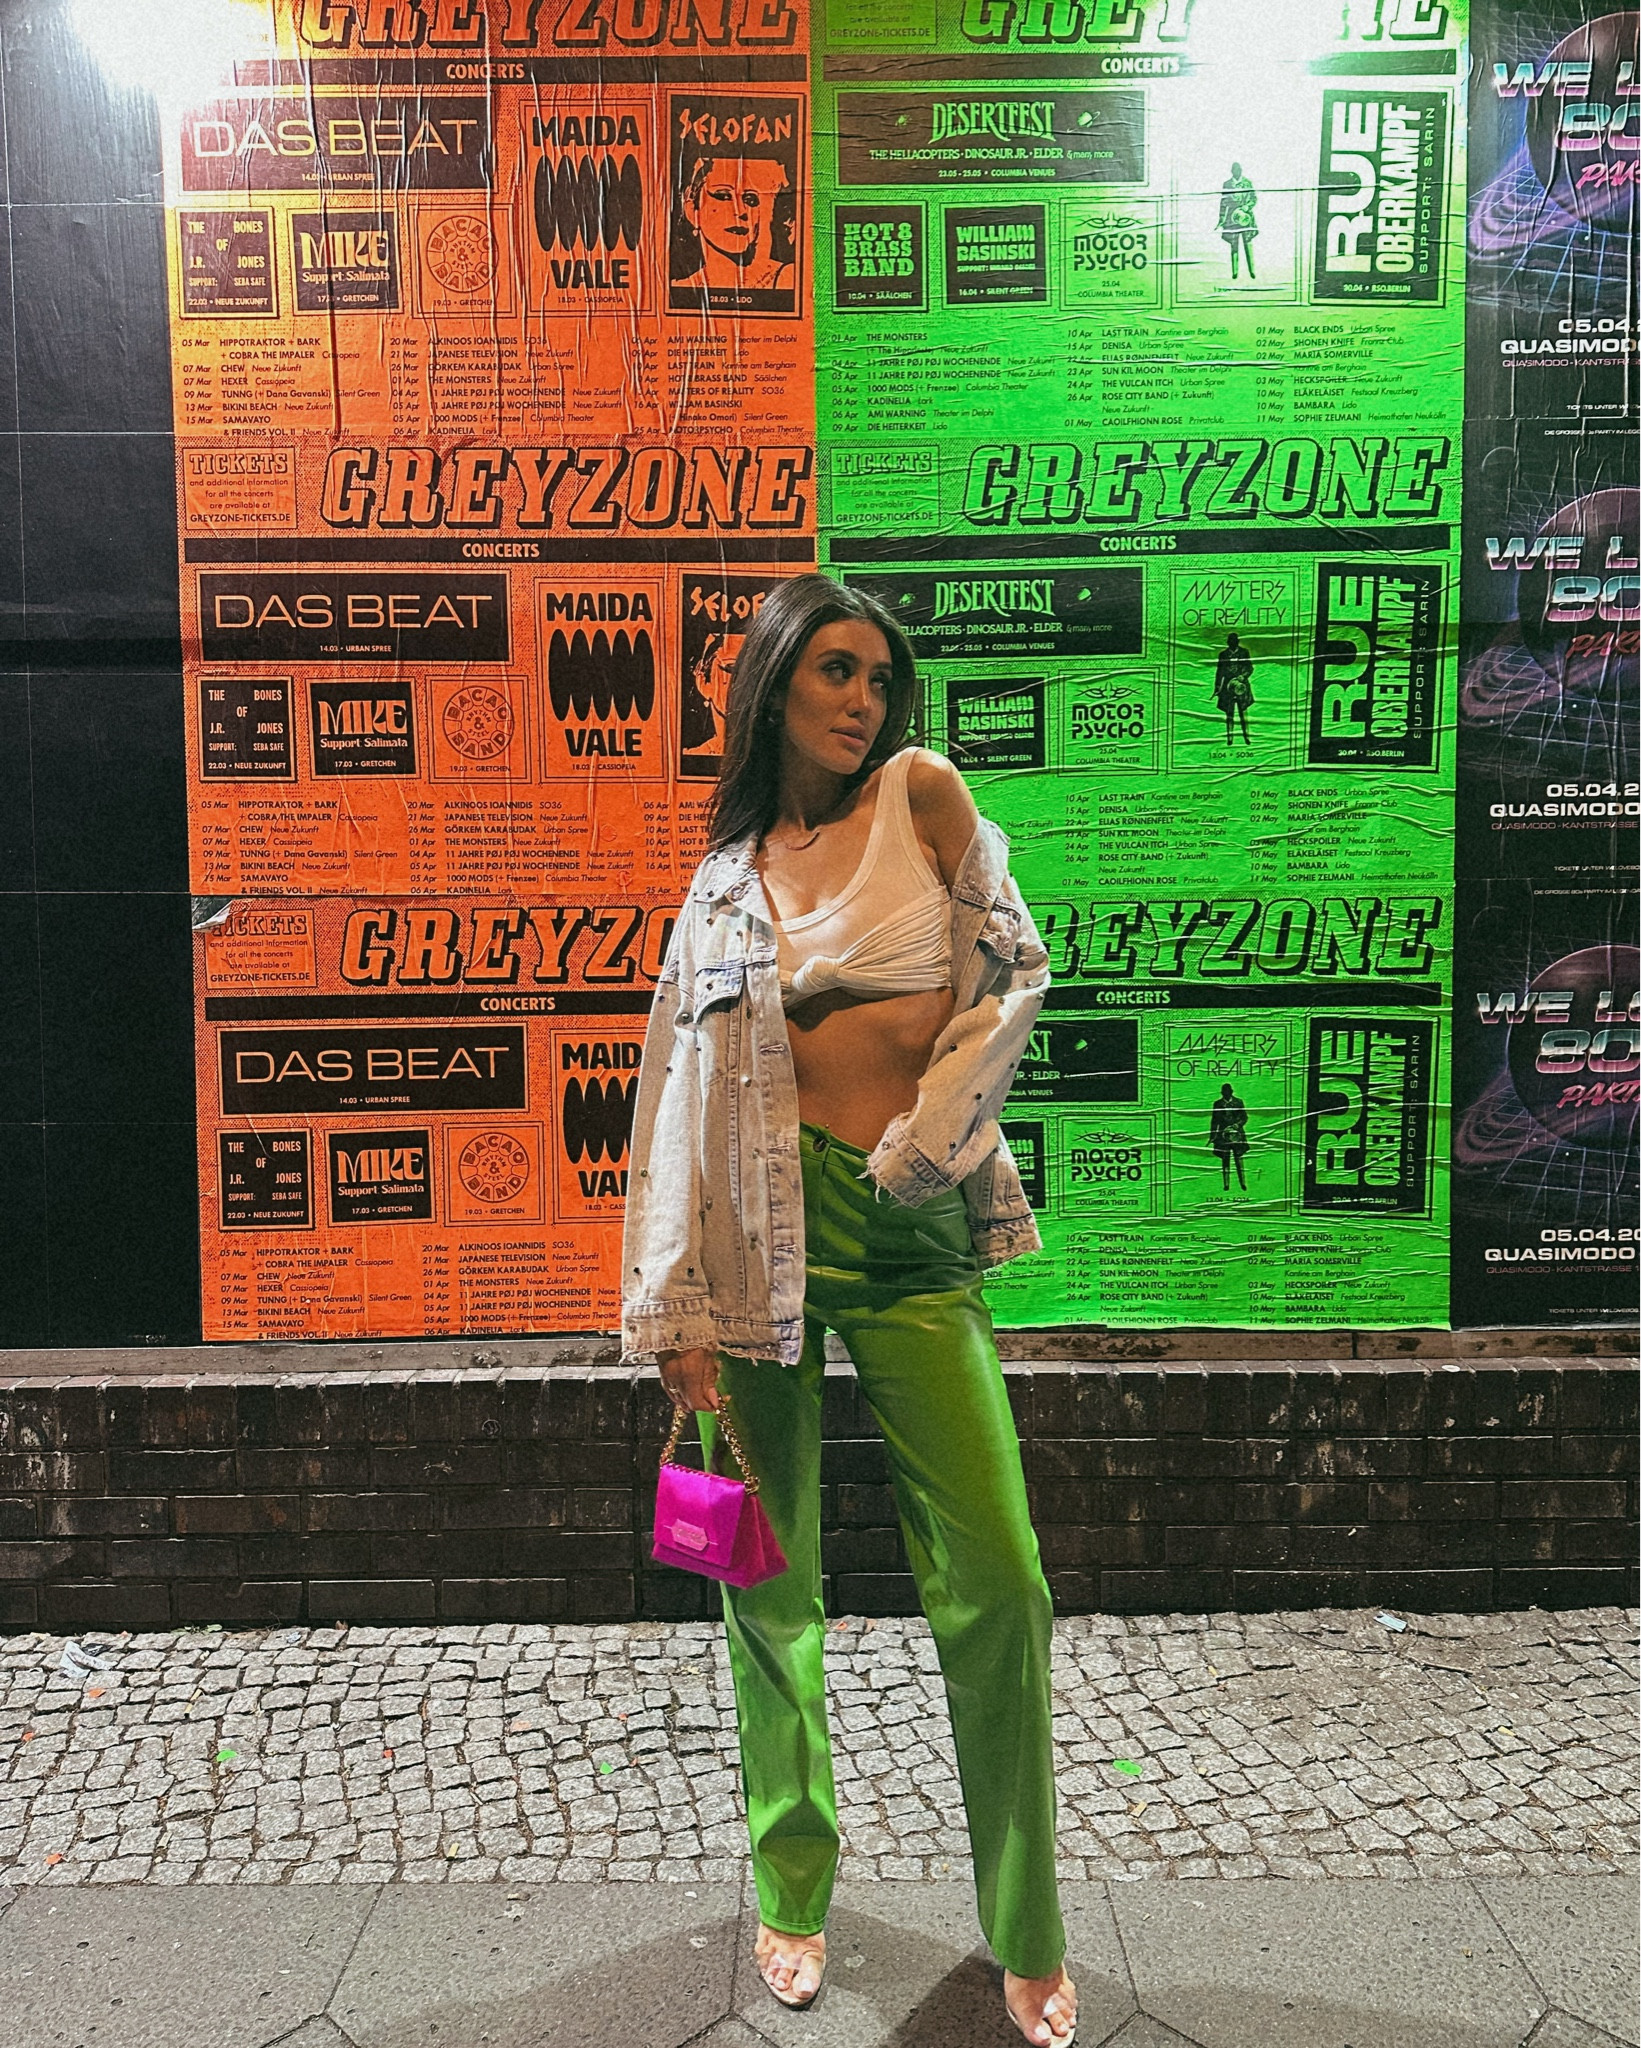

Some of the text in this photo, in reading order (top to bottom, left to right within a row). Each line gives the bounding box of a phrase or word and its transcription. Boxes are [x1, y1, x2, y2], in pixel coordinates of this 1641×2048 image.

[446, 63, 525, 79] CONCERTS
[1101, 56, 1180, 74] CONCERTS
[1493, 62, 1592, 97] WE
[679, 108, 791, 145] SELOFAN
[928, 101, 1056, 144] DESERTFEST
[193, 119, 477, 157] DAS BEAT
[533, 115, 641, 147] MAIDA
[1424, 107, 1435, 166] SARIN
[1034, 148, 1063, 159] ELDER
[1326, 102, 1379, 273] RUE
[1375, 102, 1421, 273] OBERKAMPF
[187, 220, 263, 234] THE BONES
[844, 222, 912, 241] HOT 8
[956, 224, 1035, 243] WILLIAM
[216, 238, 228, 251] OF
[300, 231, 389, 269] MIKE
[844, 240, 913, 258] BRASS
[1074, 234, 1147, 251] MOTOR
[957, 244, 1036, 261] BASINSKI
[190, 256, 265, 269] J.R. JONES
[844, 258, 915, 277] BAND
[1074, 253, 1147, 271] PSYCHO
[551, 259, 629, 289] VALE
[867, 333, 883, 341] THE
[1102, 328, 1149, 337] LAST TRAIN
[1294, 325, 1344, 334] BLACK ENDS
[219, 338, 321, 347] HIPPOTRAKTOR BARK
[1331, 338, 1354, 346] KNIFE
[229, 351, 315, 359] COBRA THE IMPALER
[221, 365, 245, 373] CHEW
[221, 378, 248, 386] HEXER
[1119, 379, 1153, 387] VULCAN
[222, 390, 253, 398] TUNNG
[223, 403, 277, 411] BIKINI BEACH
[886, 410, 926, 418] WARNING
[223, 416, 271, 424] SAMAVAYO
[189, 454, 288, 474] TICKETS
[836, 452, 932, 473] TICKETS
[320, 446, 814, 529] GREYZONE
[962, 436, 1451, 526] GREYZONE
[190, 513, 291, 522] GREYZONE-TICKETS.DE
[836, 513, 933, 523] GREYZONE-TICKETS.DE
[462, 543, 540, 558] CONCERTS
[1100, 535, 1177, 551] CONCERTS
[1486, 537, 1585, 570] WE
[931, 579, 1055, 621] DESERTFEST
[1183, 579, 1286, 605] MASTERS
[214, 593, 492, 629] DAS BEAT
[546, 592, 653, 622] MAIDA
[1419, 579, 1430, 636] SARIN
[1183, 608, 1286, 626] OF REALITY
[1033, 623, 1063, 633] ELDER
[1321, 575, 1375, 738] RUE
[1370, 576, 1416, 738] OBERKAMPF
[208, 690, 282, 701] THE BONES
[236, 706, 248, 718] OF
[958, 696, 1034, 714] WILLIAM
[1072, 704, 1145, 721] MOTOR
[318, 700, 408, 735] MIKE
[958, 714, 1034, 730] BASINSKI
[210, 723, 283, 734] J.R. JONES
[1072, 722, 1144, 739] PSYCHO
[364, 738, 408, 747] Salimata
[565, 729, 642, 757] VALE
[335, 760, 352, 768] 17.03
[444, 813, 533, 822] JAPANESE TELEVISION
[1490, 802, 1640, 817] QUASIMODO
[1562, 821, 1638, 829] KANTSTRASSE
[210, 972, 310, 982] GREYZONE-TICKETS.DE
[480, 997, 556, 1011] CONCERTS
[1096, 991, 1171, 1004] CONCERTS
[1477, 992, 1574, 1024] WE
[1177, 1033, 1278, 1057] MASTERS
[367, 1047, 510, 1081] BEAT
[562, 1042, 645, 1070] MAID
[1410, 1035, 1420, 1089] SARIN
[236, 1050, 353, 1084] DAS
[1177, 1060, 1279, 1076] OF REALITY
[1316, 1030, 1365, 1185] RUE
[1364, 1031, 1407, 1186] OBERKAMPF
[228, 1141, 301, 1152] THE BONES
[256, 1158, 267, 1168] OF
[1072, 1149, 1142, 1164] MOTOR
[336, 1147, 424, 1183] MIKE
[229, 1173, 302, 1185] J.R. JONES
[1072, 1166, 1142, 1182] PSYCHO
[382, 1184, 424, 1194] Salimata
[378, 1205, 412, 1213] GRETCHEN
[257, 1248, 320, 1256] HIPPOTRAKTOR
[459, 1242, 546, 1251] ALKINOOS IOANNIDIS
[1485, 1247, 1635, 1261] QUASIMODO
[1487, 1266, 1550, 1274] QUASIMODO
[475, 1278, 520, 1286] MONSTERS
